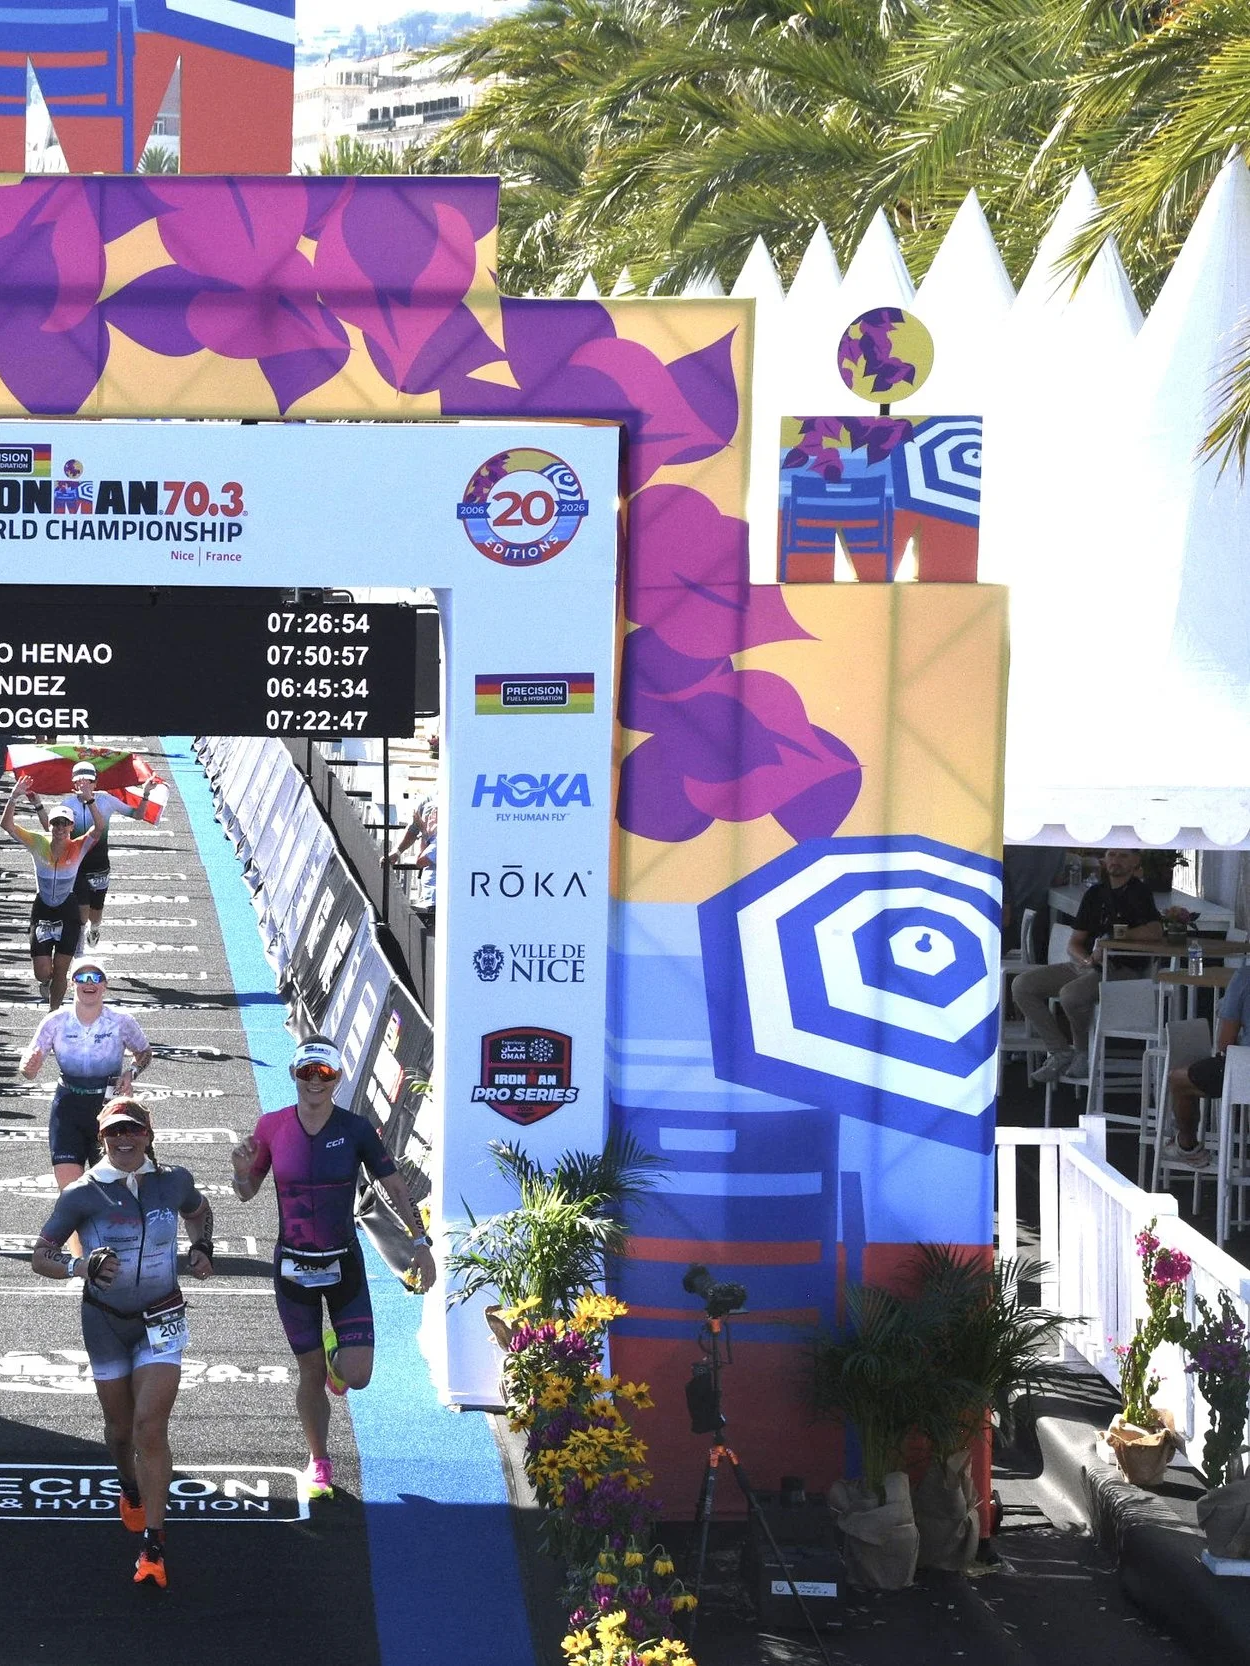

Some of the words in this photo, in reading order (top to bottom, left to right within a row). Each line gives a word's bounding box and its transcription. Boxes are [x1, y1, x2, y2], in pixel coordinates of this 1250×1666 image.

[163, 481, 245, 517] 70.3
[492, 490, 555, 527] 20
[561, 503, 586, 512] 2026
[460, 506, 485, 515] 2006
[45, 520, 244, 543] CHAMPIONSHIP
[170, 550, 195, 561] Nice
[205, 551, 242, 562] France
[484, 534, 559, 559] EDITIONS
[267, 613, 370, 633] 07:26:54
[22, 644, 113, 664] HENAO
[266, 646, 369, 666] 07:50:57
[266, 678, 369, 698] 06:45:34
[506, 686, 563, 696] PRECISION
[266, 710, 368, 730] 07:22:47
[471, 774, 592, 808] HOKA
[496, 813, 511, 822] FLY
[513, 813, 550, 821] HUMAN
[508, 944, 556, 958] VILLE
[562, 944, 586, 958] DE
[509, 959, 586, 983] NICE
[473, 1088, 510, 1100] PRO
[513, 1088, 578, 1102] SERIES
[34, 1498, 270, 1512] HYDTION
